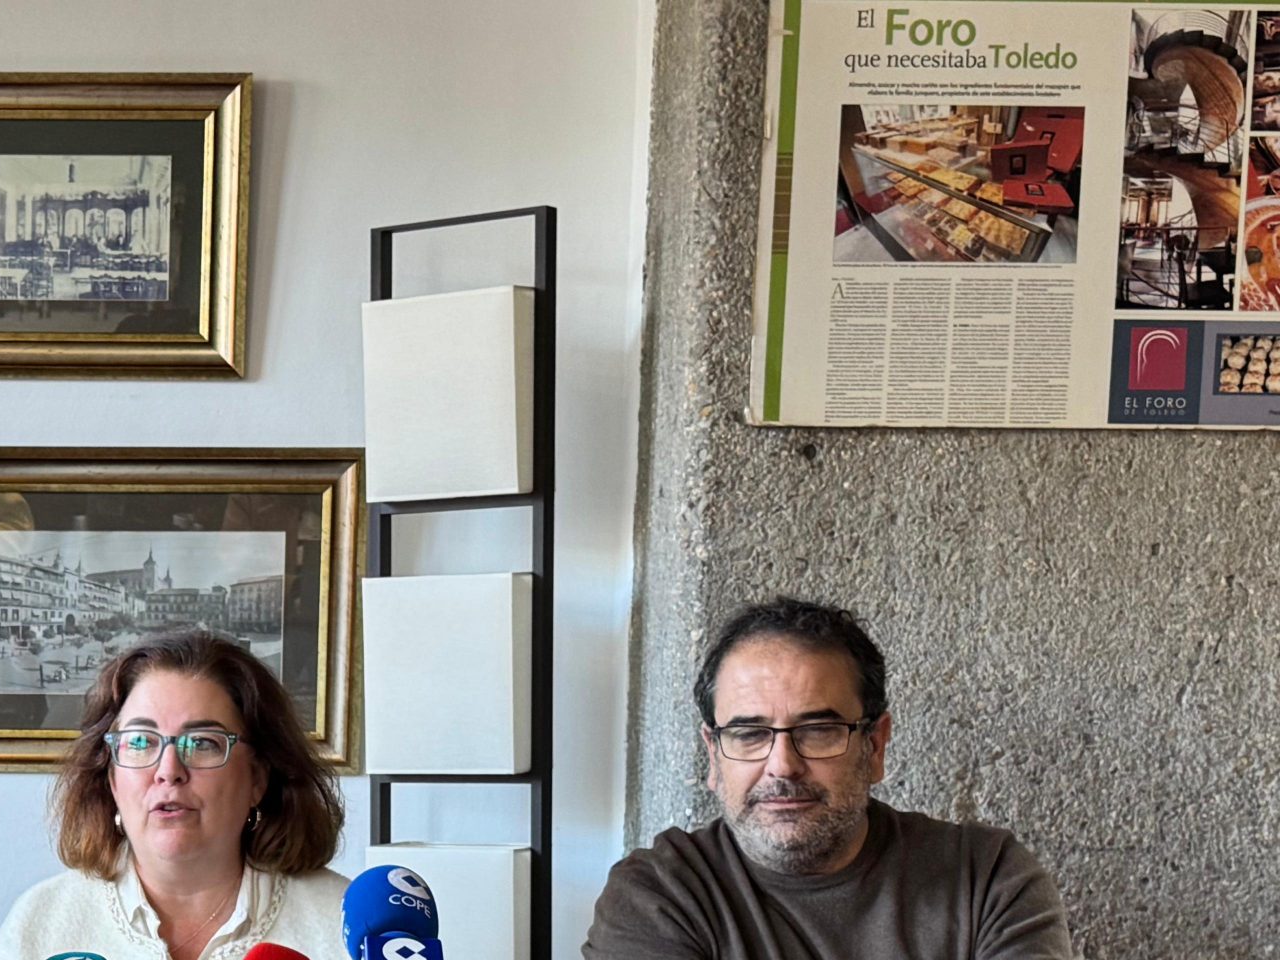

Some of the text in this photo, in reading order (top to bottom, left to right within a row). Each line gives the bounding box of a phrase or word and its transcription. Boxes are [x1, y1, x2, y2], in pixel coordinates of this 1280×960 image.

[856, 8, 977, 47] El Foro
[843, 44, 1078, 73] que necesitaba Toledo
[1124, 397, 1187, 408] EL FORO
[388, 893, 431, 919] COPE
